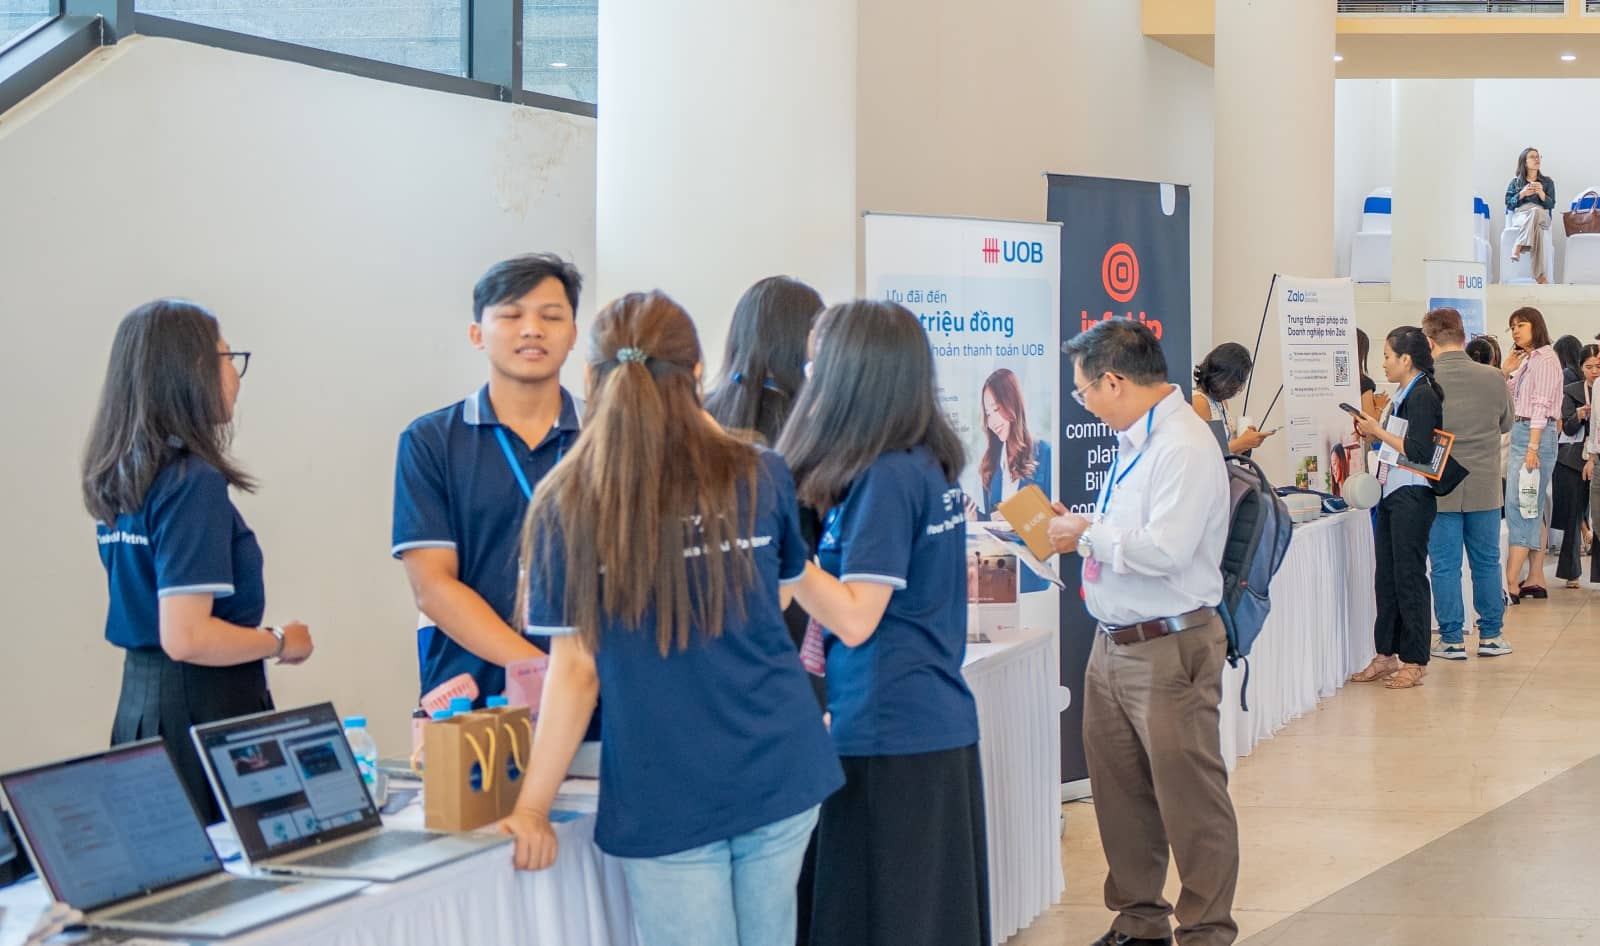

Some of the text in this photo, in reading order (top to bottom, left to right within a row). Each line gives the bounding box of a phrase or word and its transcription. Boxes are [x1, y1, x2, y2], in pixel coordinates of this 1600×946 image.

[1003, 241, 1043, 263] UOB
[1466, 276, 1483, 288] UOB
[907, 290, 924, 303] đãi
[927, 289, 947, 303] đến
[1288, 289, 1304, 302] Zalo
[919, 310, 1014, 338] triệu đồng
[931, 343, 1045, 357] hoản thanh toán UOB
